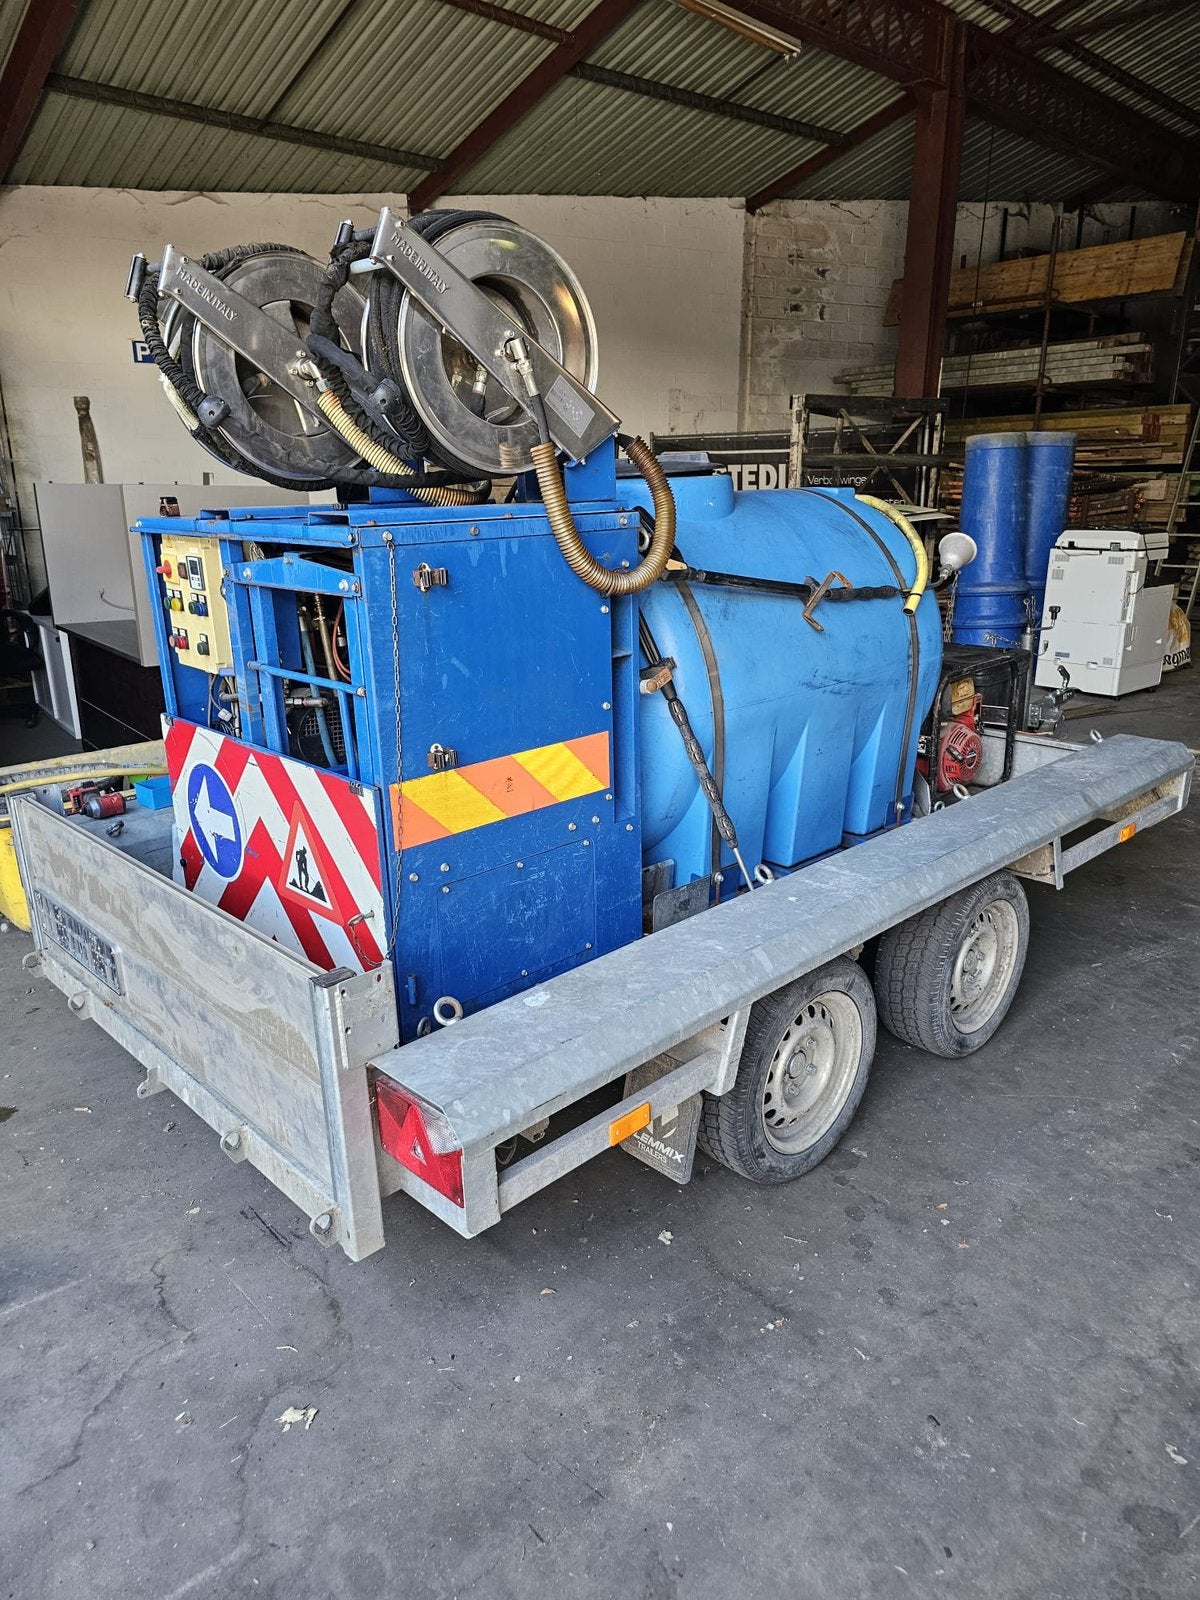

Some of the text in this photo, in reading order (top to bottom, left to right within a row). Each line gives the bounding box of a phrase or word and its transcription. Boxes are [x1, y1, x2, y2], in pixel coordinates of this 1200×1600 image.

[390, 231, 419, 264] MADE
[424, 266, 450, 294] ITALY
[176, 266, 205, 296] MADE
[211, 296, 240, 321] ITALY
[135, 342, 151, 362] P
[637, 1140, 668, 1164] TRAILERS
